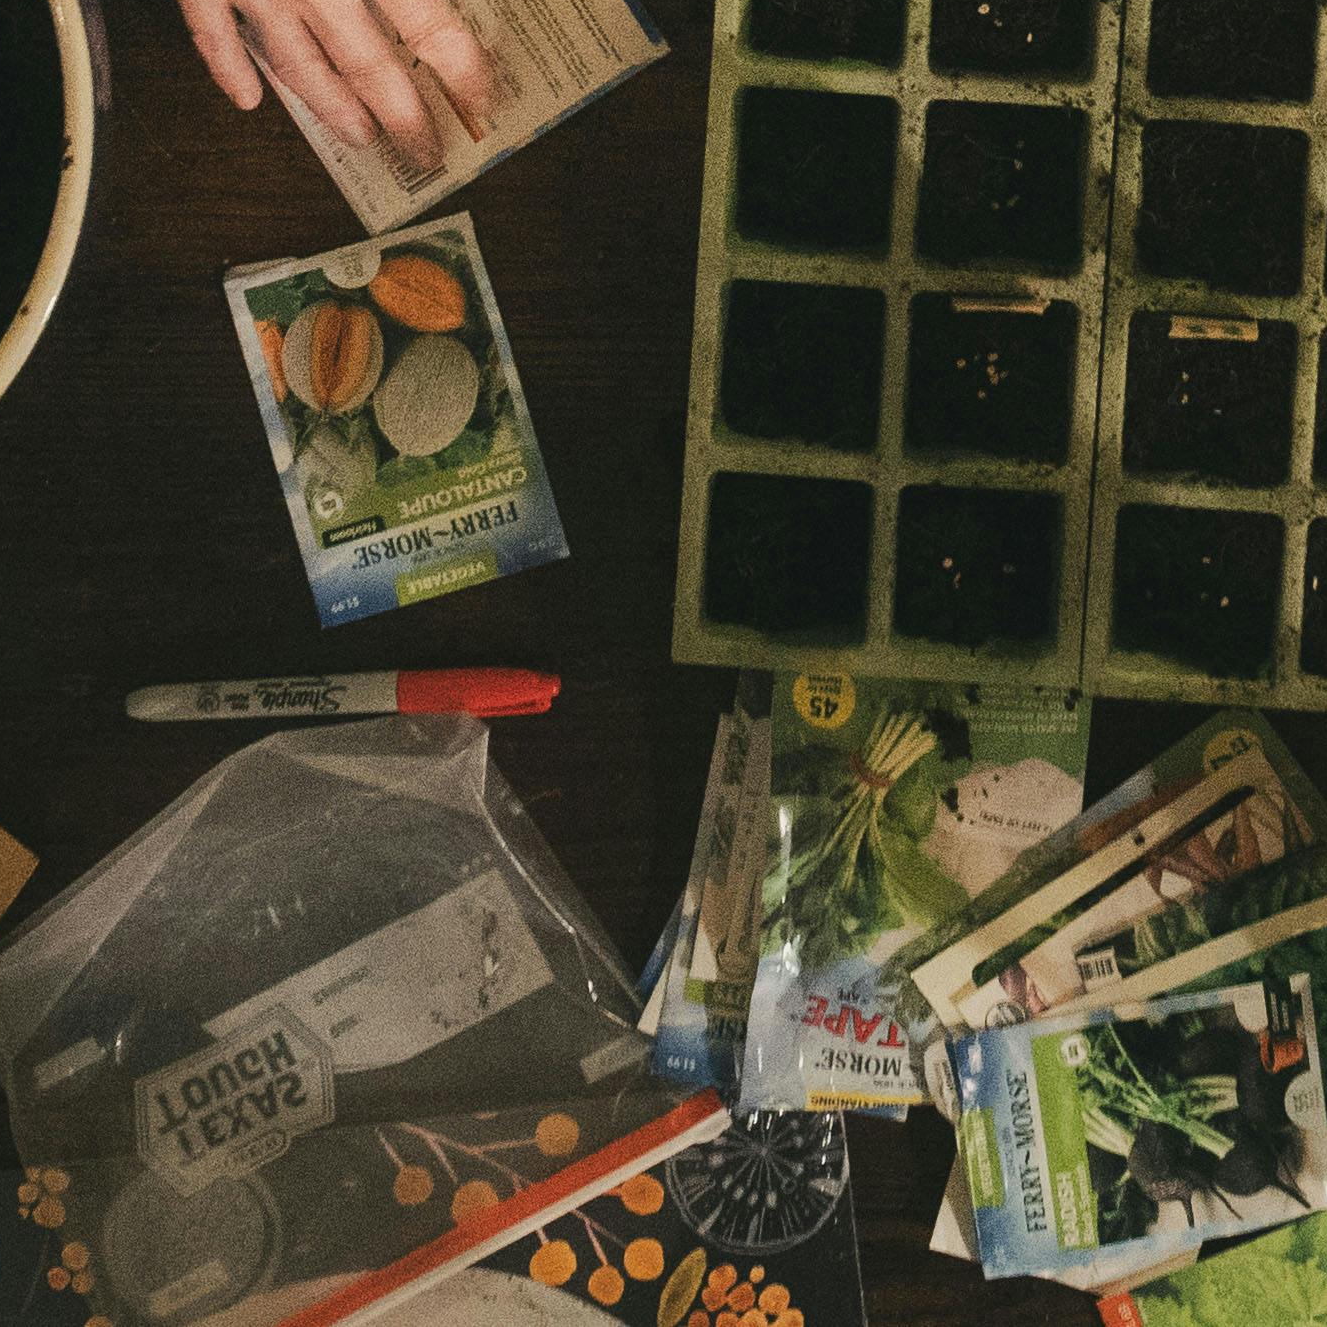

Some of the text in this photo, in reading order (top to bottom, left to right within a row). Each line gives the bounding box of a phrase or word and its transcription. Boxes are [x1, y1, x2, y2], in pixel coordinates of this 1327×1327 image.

[395, 462, 529, 519] CANTALOUPE
[456, 461, 487, 480] Gold
[327, 559, 487, 614] VEGETABLE $1.99
[808, 696, 838, 720] 45
[800, 993, 906, 1048] TAPE
[819, 1047, 902, 1077] MORSE
[1055, 1171, 1082, 1247] RADISH
